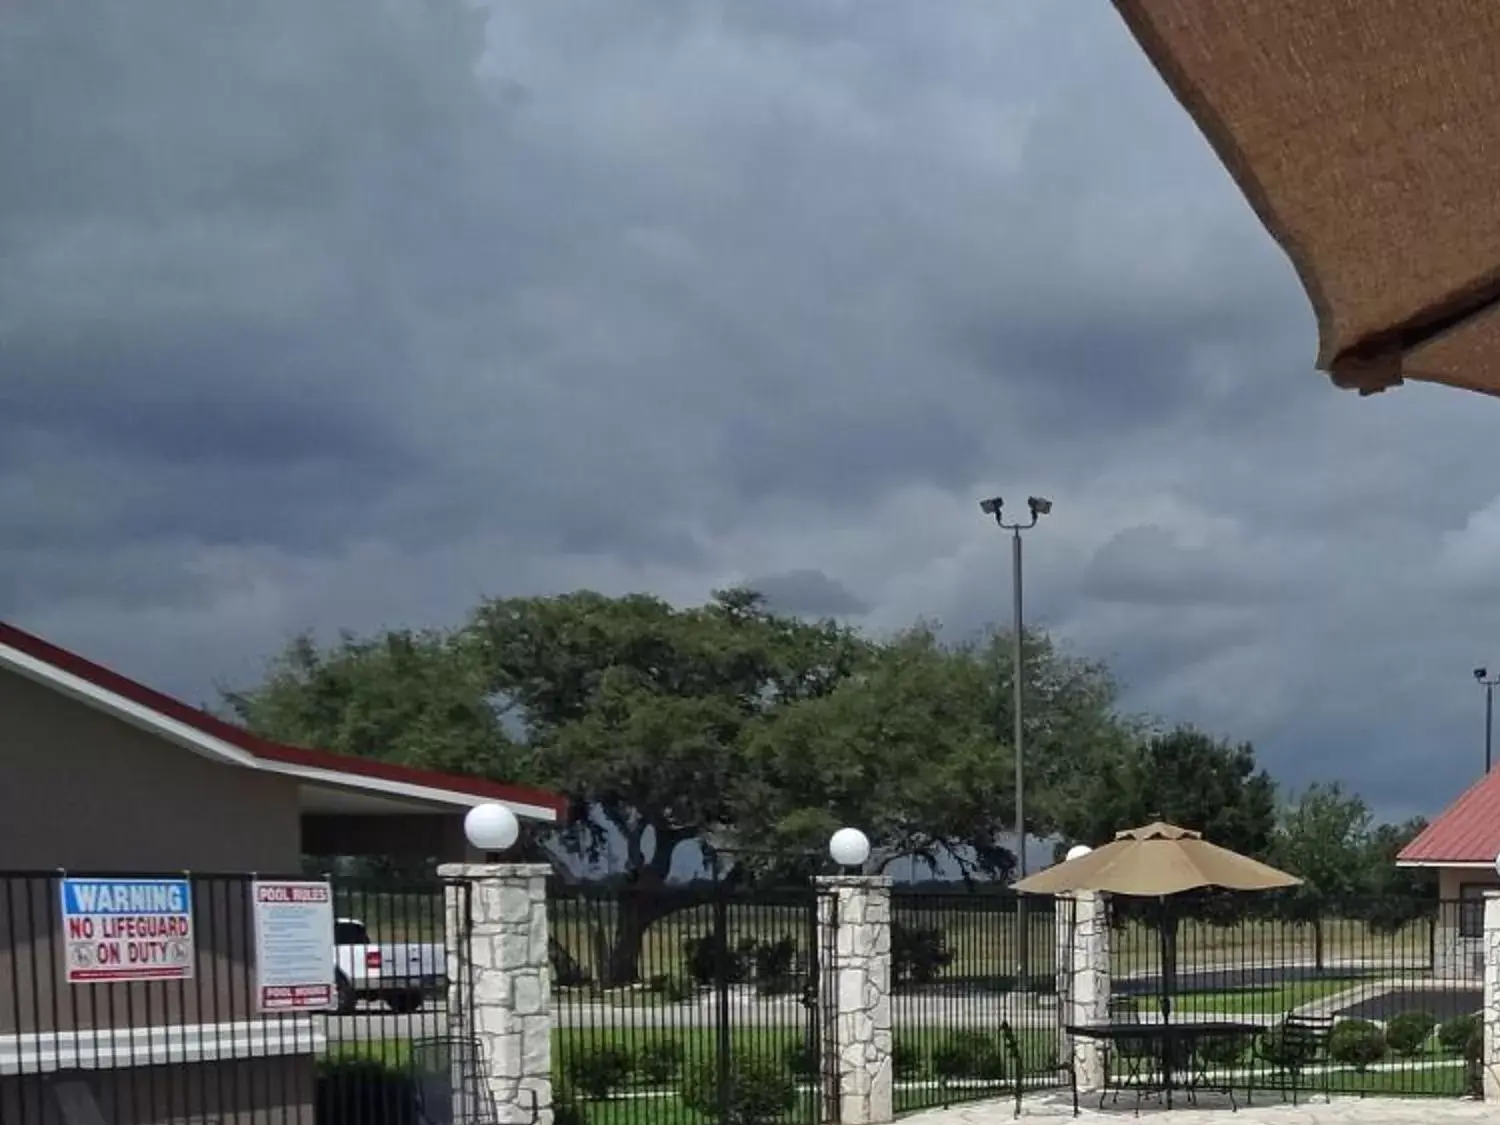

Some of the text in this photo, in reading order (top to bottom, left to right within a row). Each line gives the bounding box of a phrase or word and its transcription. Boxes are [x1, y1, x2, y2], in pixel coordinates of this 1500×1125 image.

[73, 884, 182, 912] WARNING
[260, 888, 328, 902] POOL RULES
[69, 916, 188, 939] NO LIFEGUARD
[98, 941, 168, 964] ON DUTY
